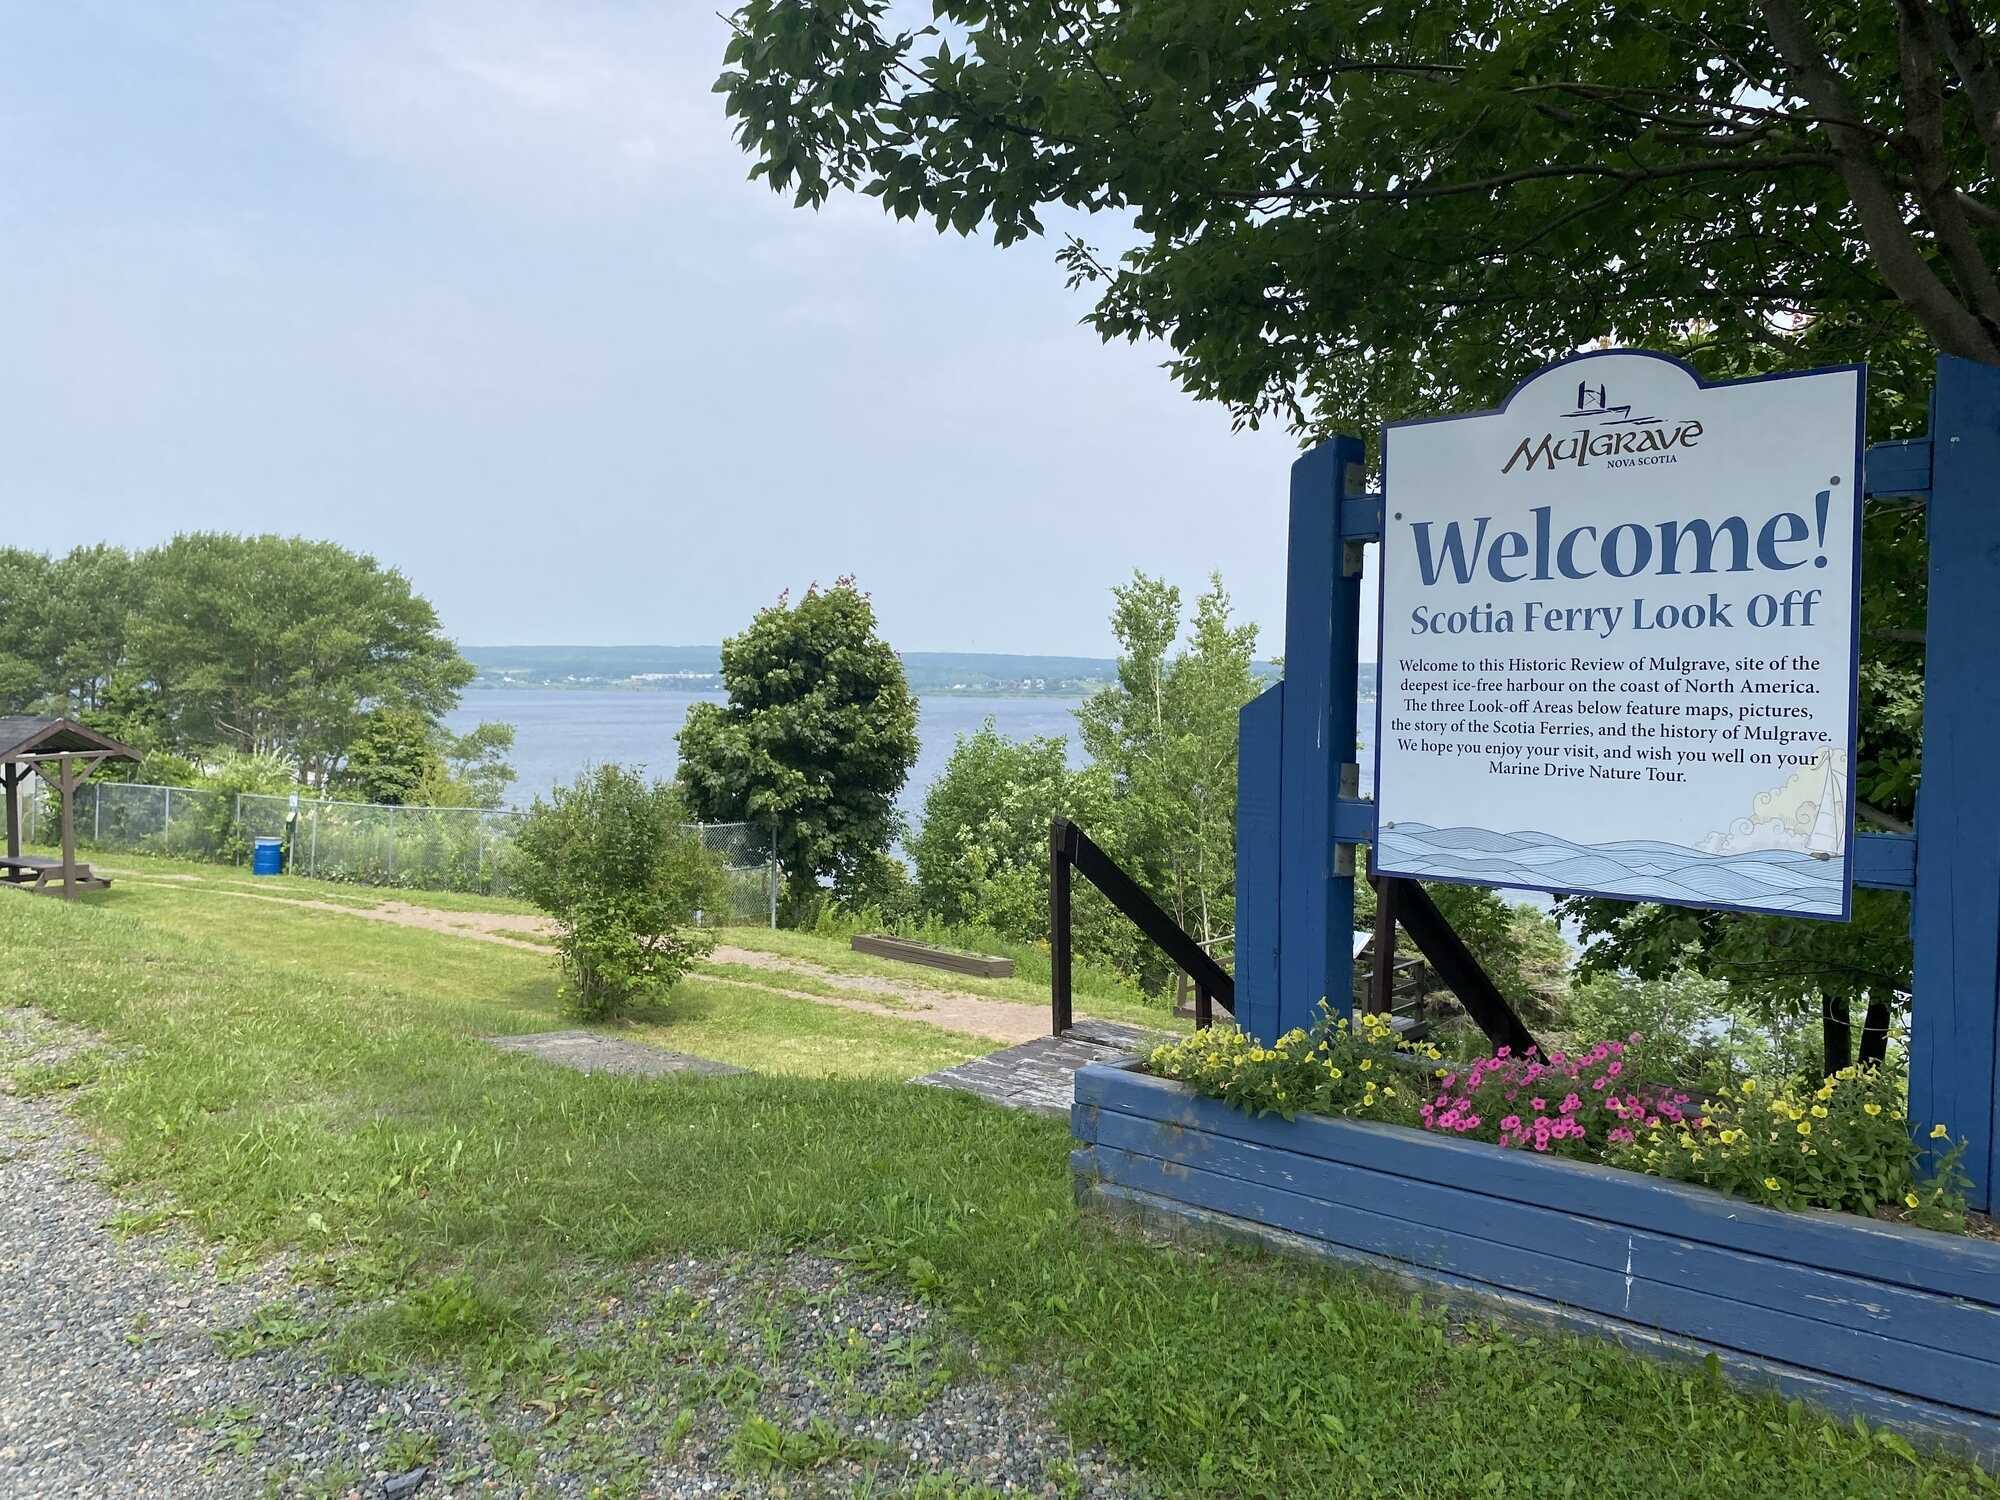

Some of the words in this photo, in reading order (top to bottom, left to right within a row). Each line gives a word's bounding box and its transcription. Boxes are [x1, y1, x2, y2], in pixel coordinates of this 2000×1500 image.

[1501, 420, 1703, 474] Mulgrave
[1607, 457, 1636, 469] NOVA
[1638, 454, 1678, 467] SCOTIA
[1409, 490, 1830, 585] Welcome!
[1411, 603, 1514, 634] Scotia
[1523, 602, 1624, 639] Ferry
[1632, 593, 1734, 629] Look
[1747, 589, 1821, 627] Off
[1400, 659, 1458, 671] Welcome
[1462, 660, 1475, 671] to
[1479, 658, 1504, 671] this
[1508, 658, 1566, 671] Historic
[1570, 658, 1624, 671] Review
[1629, 656, 1646, 671] of
[1649, 656, 1730, 675] Mulgrave,
[1736, 658, 1764, 670] site
[1769, 656, 1789, 670] of
[1791, 656, 1820, 670] the
[1401, 678, 1449, 692] deepest
[1453, 678, 1502, 691] ice-free
[1507, 678, 1564, 692] harbour
[1569, 683, 1587, 692] on
[1592, 678, 1615, 692] the
[1620, 681, 1659, 692] coast
[1664, 678, 1682, 692] of
[1685, 678, 1734, 693] North
[1740, 680, 1819, 693] America.
[1404, 698, 1427, 711] The
[1431, 699, 1464, 711] three
[1469, 699, 1530, 713] Look-off
[1533, 700, 1573, 713] Areas
[1578, 700, 1622, 714] below
[1626, 701, 1680, 715] feature
[1685, 706, 1733, 720] maps,
[1738, 703, 1813, 721] pictures,
[1392, 718, 1411, 730] the
[1414, 720, 1447, 735] story
[1451, 719, 1466, 732] of
[1468, 720, 1489, 733] the
[1493, 720, 1535, 734] Scotia
[1540, 722, 1593, 737] Ferries,
[1599, 722, 1626, 736] and
[1631, 723, 1655, 737] the
[1660, 723, 1718, 743] history
[1722, 725, 1741, 739] of
[1744, 725, 1831, 745] Mulgrave.
[1397, 738, 1417, 751] We
[1421, 738, 1453, 756] hope
[1456, 742, 1481, 756] you
[1485, 742, 1523, 758] enjoy
[1526, 745, 1560, 759] your
[1563, 743, 1599, 759] visit,
[1603, 745, 1632, 759] and
[1637, 746, 1672, 760] wish
[1677, 751, 1707, 765] you
[1712, 748, 1744, 763] well
[1750, 754, 1772, 764] on
[1776, 755, 1819, 769] your
[1489, 761, 1540, 775] Marine
[1544, 763, 1584, 777] Drive
[1589, 765, 1641, 780] Nature
[1646, 767, 1686, 782] Tour.
